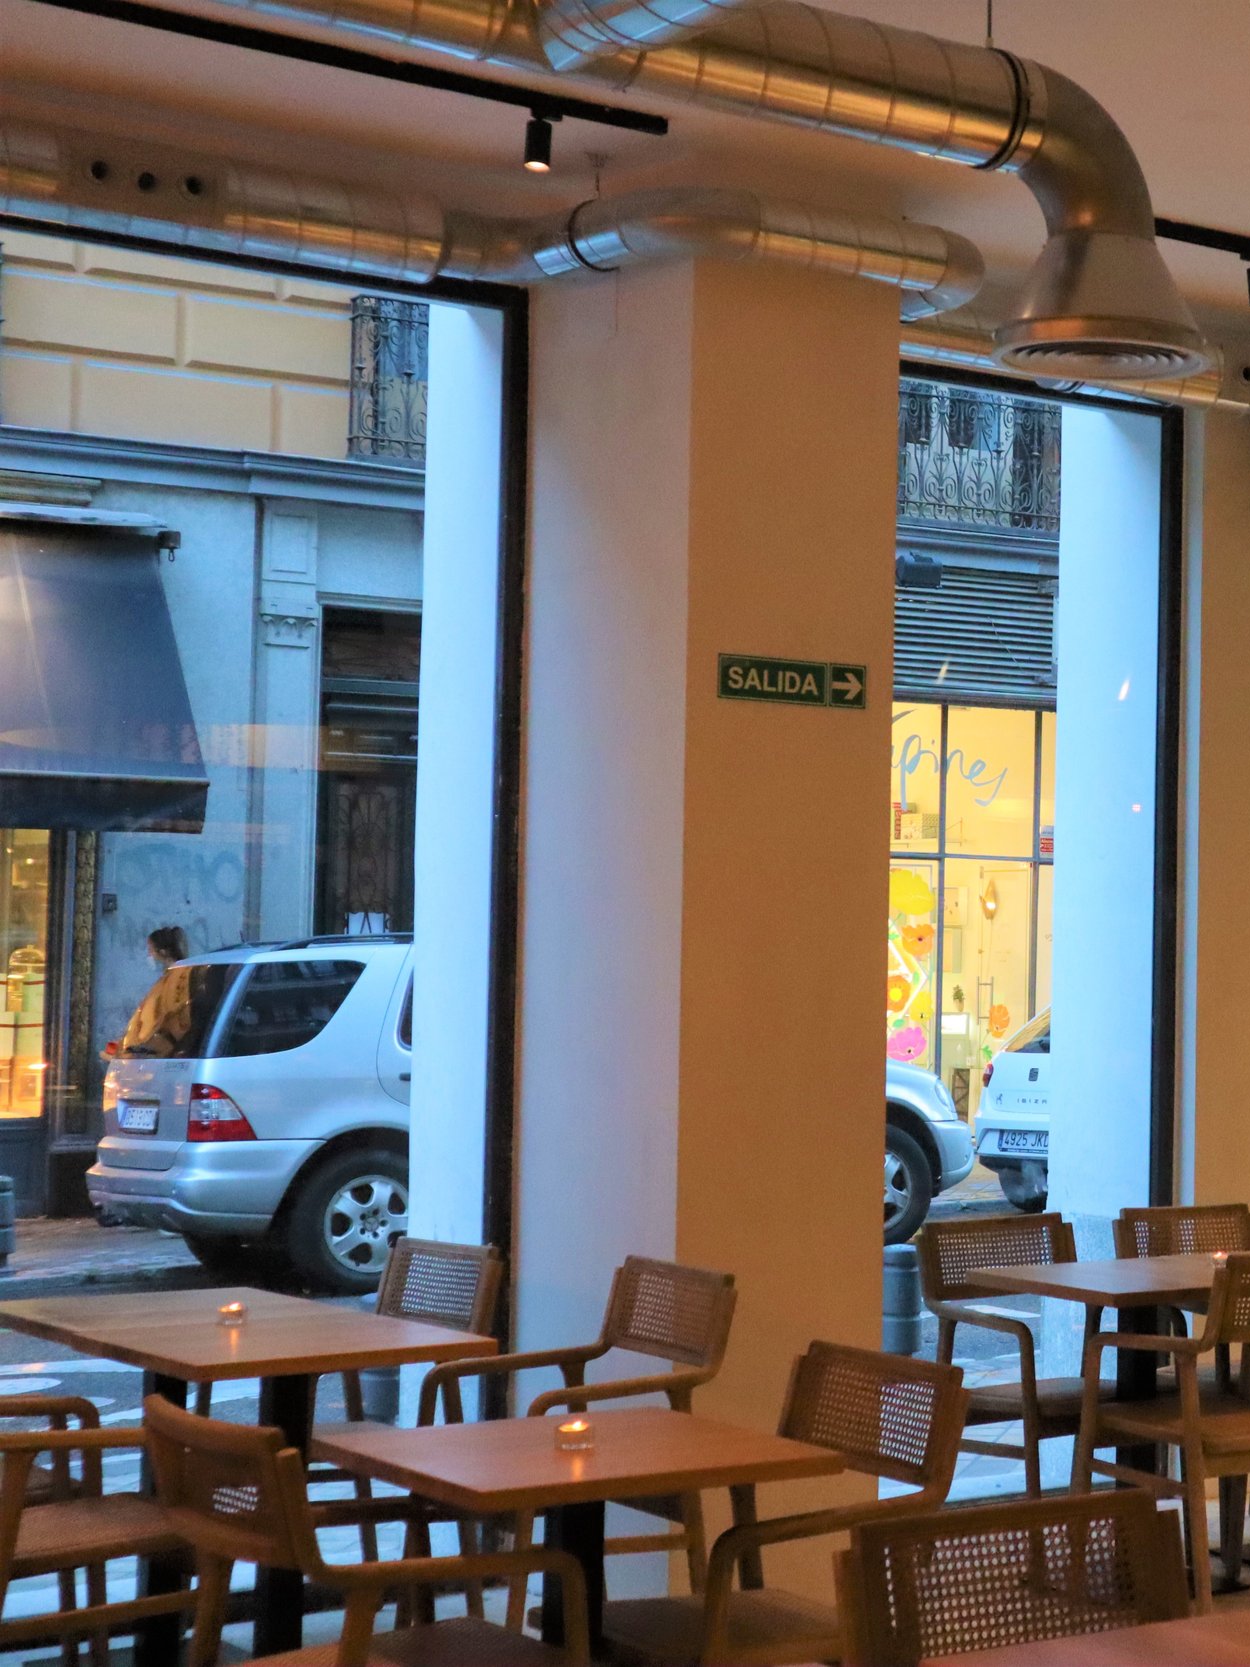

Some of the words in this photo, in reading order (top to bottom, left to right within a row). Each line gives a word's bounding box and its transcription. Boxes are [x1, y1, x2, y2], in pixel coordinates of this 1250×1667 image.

[727, 665, 819, 696] SALIDA
[890, 735, 1008, 811] pines
[1004, 1132, 1028, 1146] 4925
